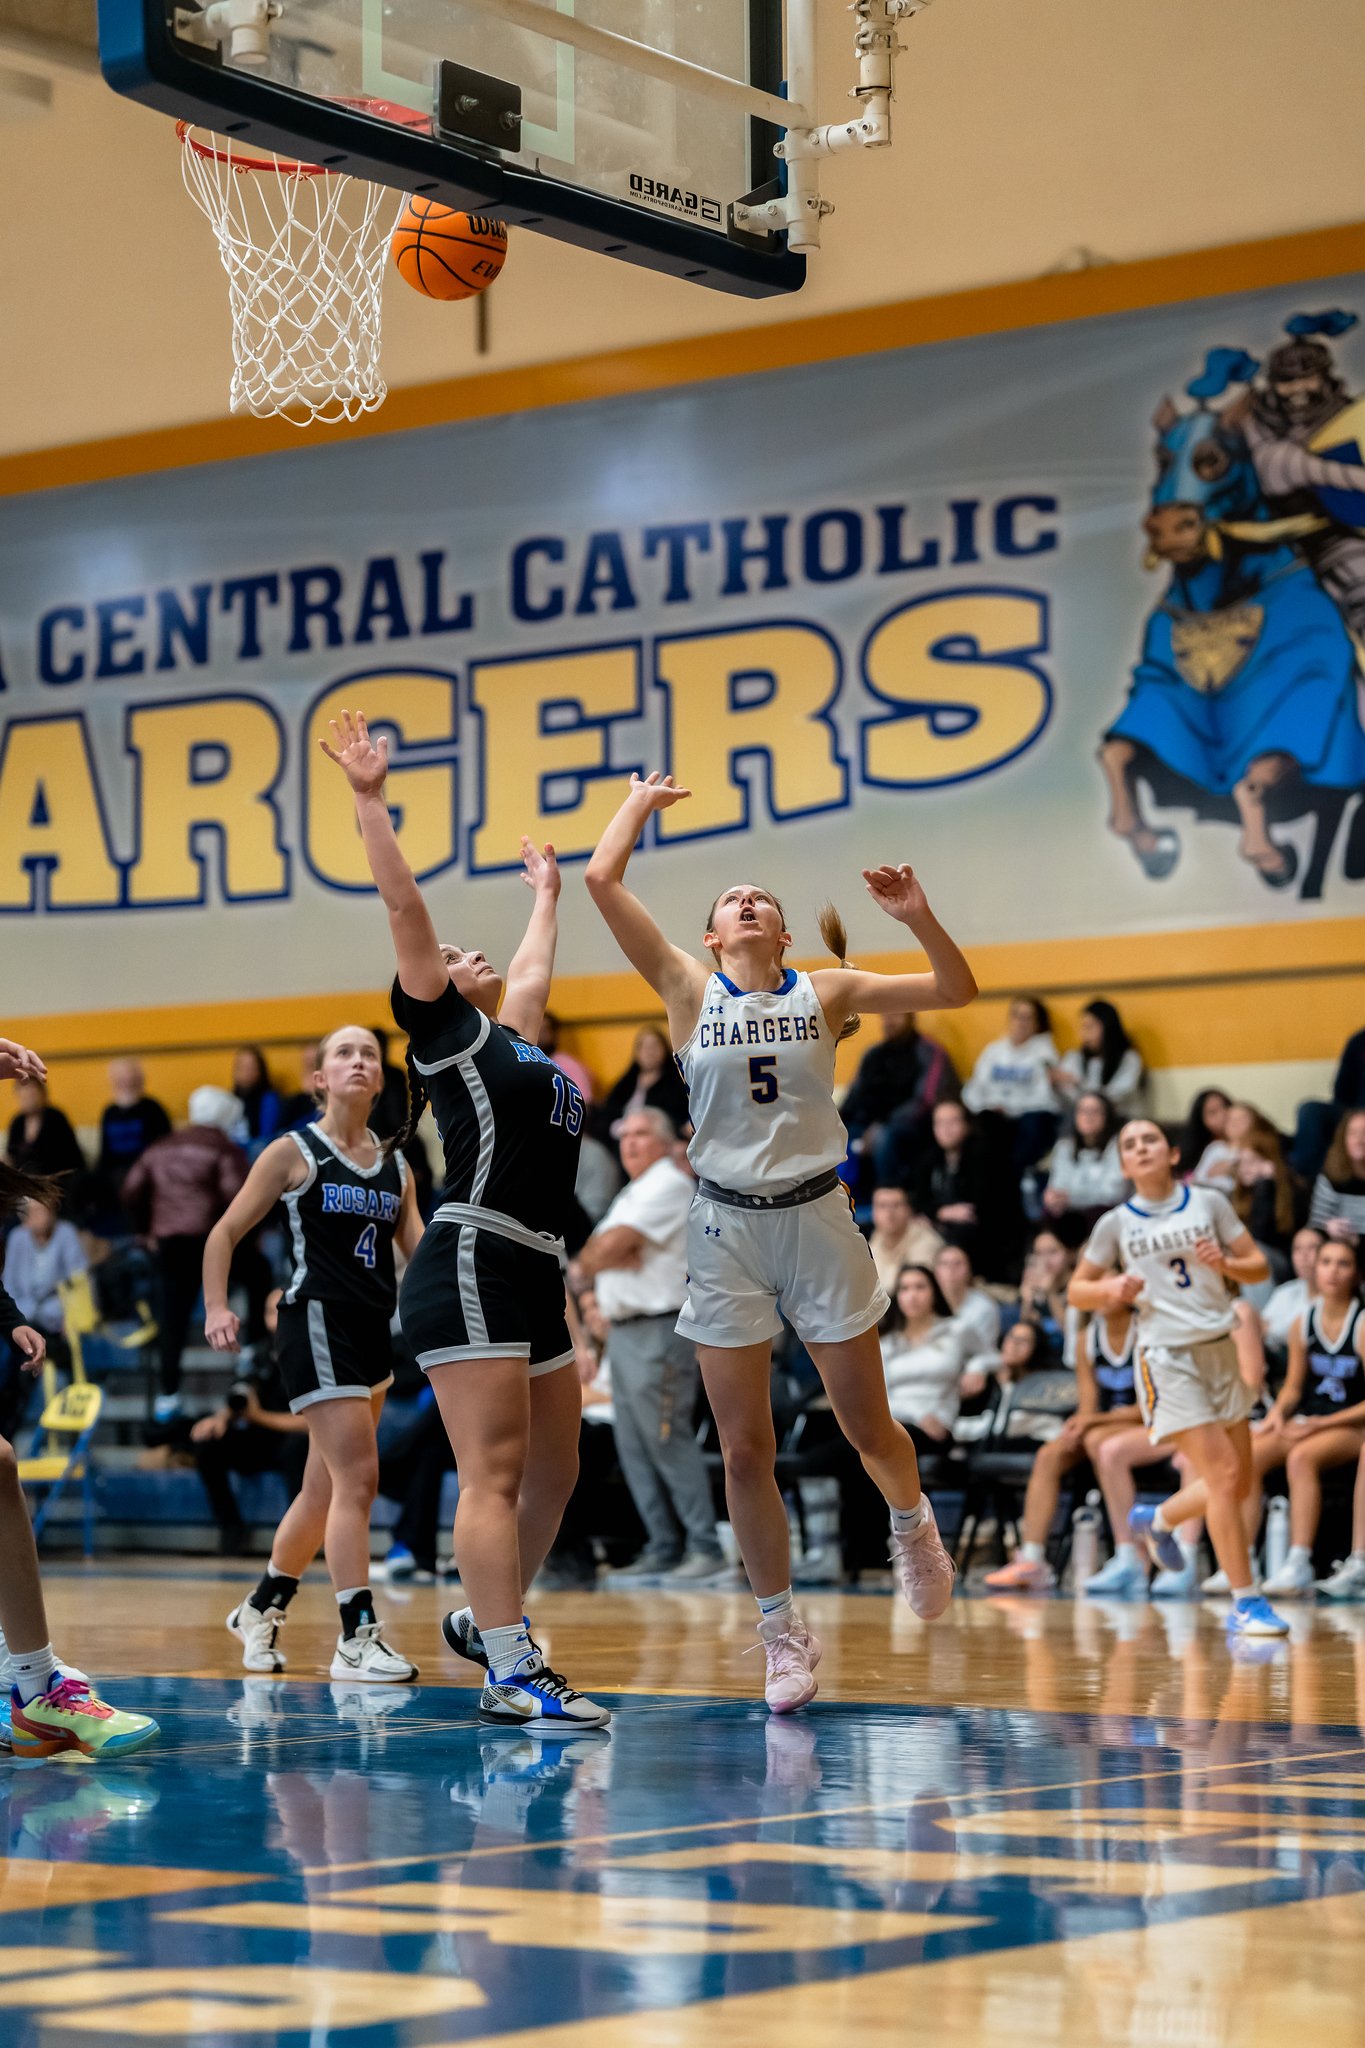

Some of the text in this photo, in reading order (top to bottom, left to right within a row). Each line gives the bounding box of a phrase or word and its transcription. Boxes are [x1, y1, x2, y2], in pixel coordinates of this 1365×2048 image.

[38, 550, 474, 685] CENTRAL
[511, 495, 1059, 623] CATHOLIC
[700, 1015, 820, 1049] CHARGERS
[748, 1055, 779, 1105] 5
[550, 1073, 583, 1136] 15
[354, 1222, 377, 1269] 4
[1169, 1257, 1191, 1288] 3
